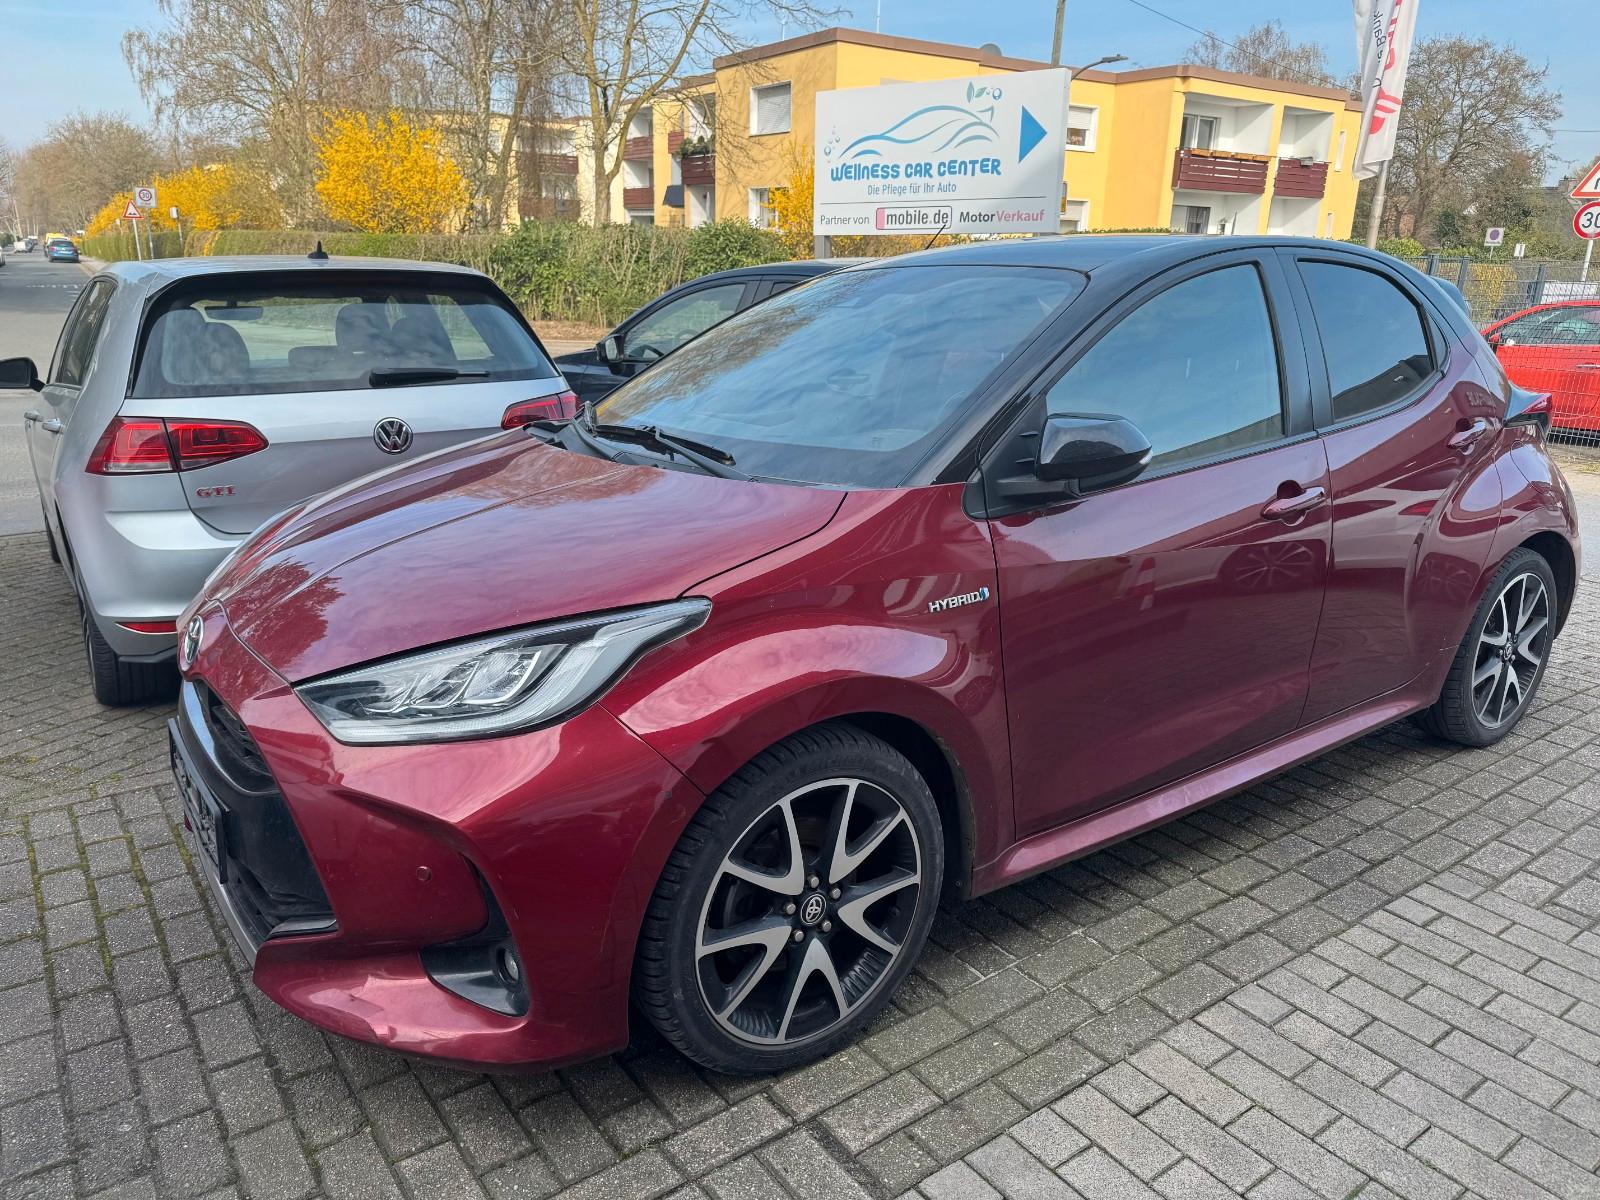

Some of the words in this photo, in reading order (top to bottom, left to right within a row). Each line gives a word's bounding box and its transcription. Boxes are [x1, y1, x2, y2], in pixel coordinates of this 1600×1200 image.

[904, 161, 933, 178] CAR
[867, 184, 880, 196] Die
[882, 183, 907, 197] Pflege
[909, 183, 920, 194] für
[923, 182, 935, 193] Ihr
[937, 181, 957, 193] Auto
[820, 214, 851, 225] Partner
[886, 209, 949, 225] mobile.de
[195, 484, 236, 497] GTI
[928, 591, 981, 613] HYBRID
